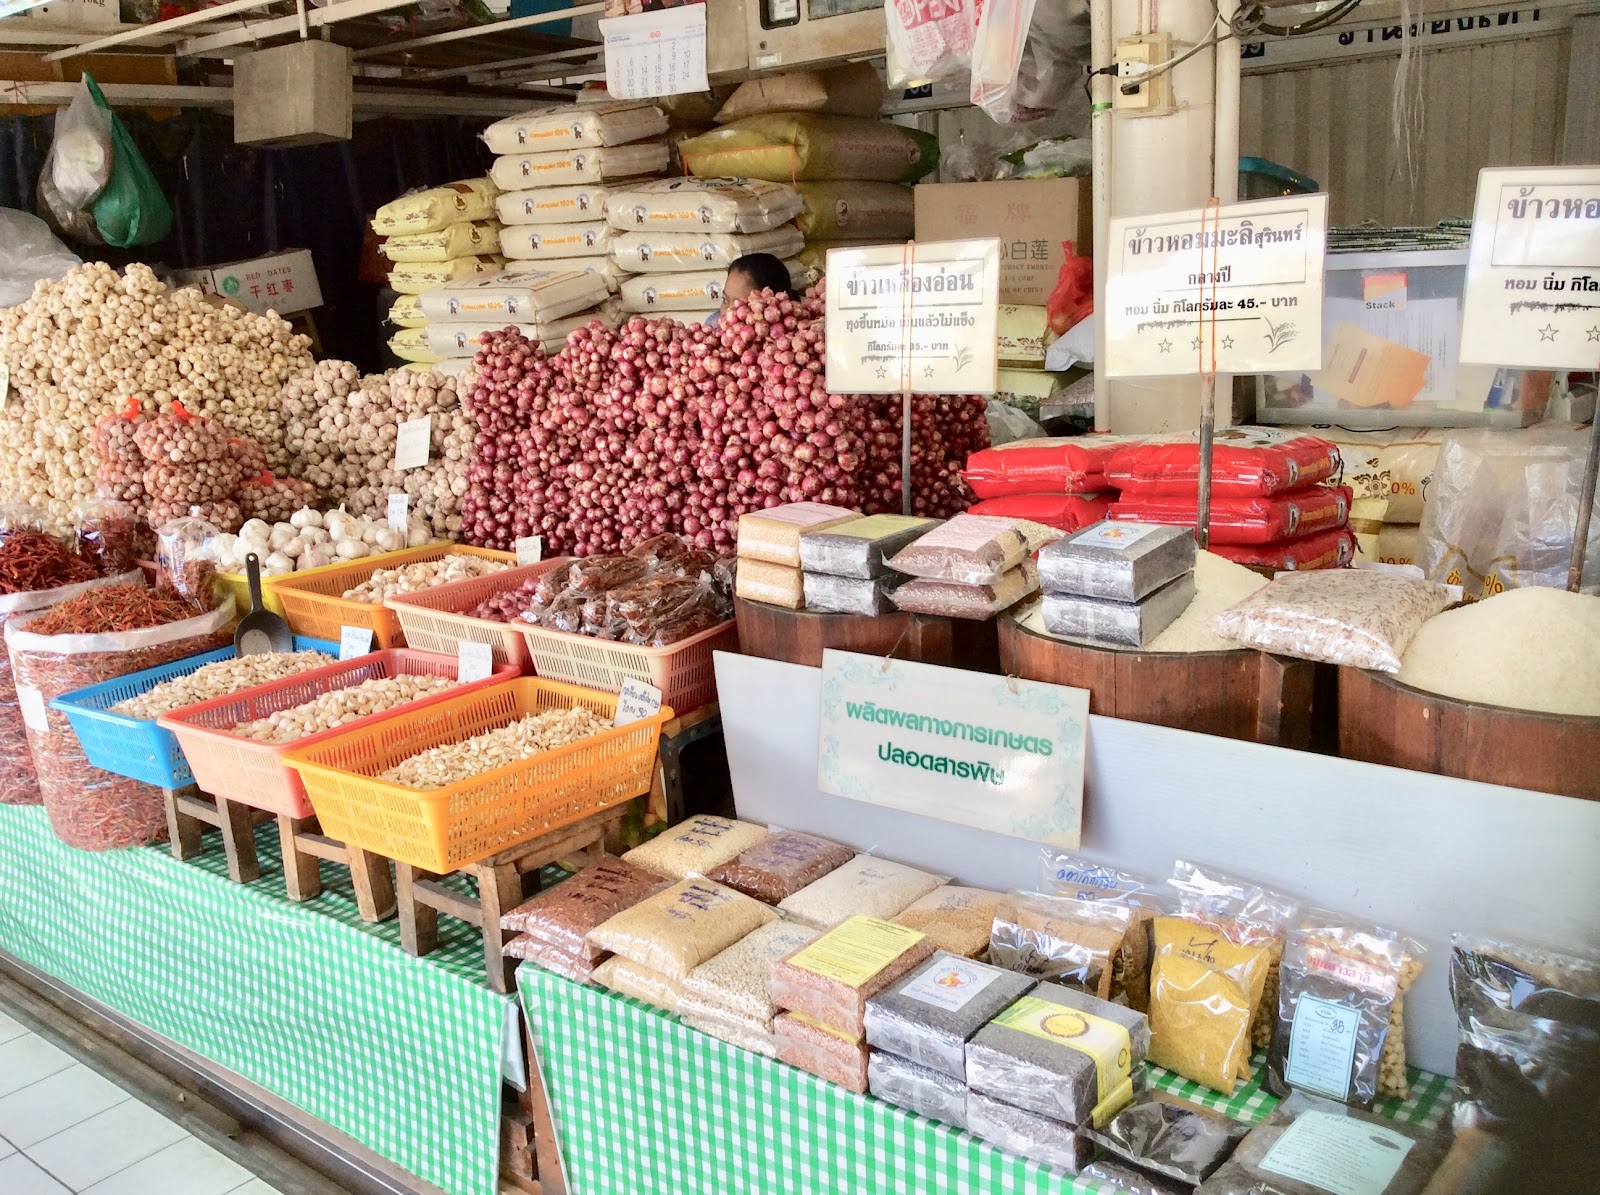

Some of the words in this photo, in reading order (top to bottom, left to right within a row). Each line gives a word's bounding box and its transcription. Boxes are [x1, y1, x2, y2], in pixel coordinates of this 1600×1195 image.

[245, 273, 261, 281] RED
[267, 266, 292, 277] DATES
[1188, 265, 1231, 285] กลางปี
[1504, 278, 1537, 291] หอม
[1543, 272, 1565, 291] นิ่ม
[1570, 275, 1600, 292] กิโล
[1125, 305, 1149, 316] หอม
[1153, 298, 1169, 314] นิ่ม
[1173, 297, 1233, 313] กิโลกรัมละ
[1271, 295, 1298, 308] บาท
[1365, 300, 1396, 310] Stack
[931, 342, 949, 350] บาท
[846, 701, 1053, 757] ผลิตผลทางการเกษตร
[878, 742, 1005, 786] ปลอดสารพิษ
